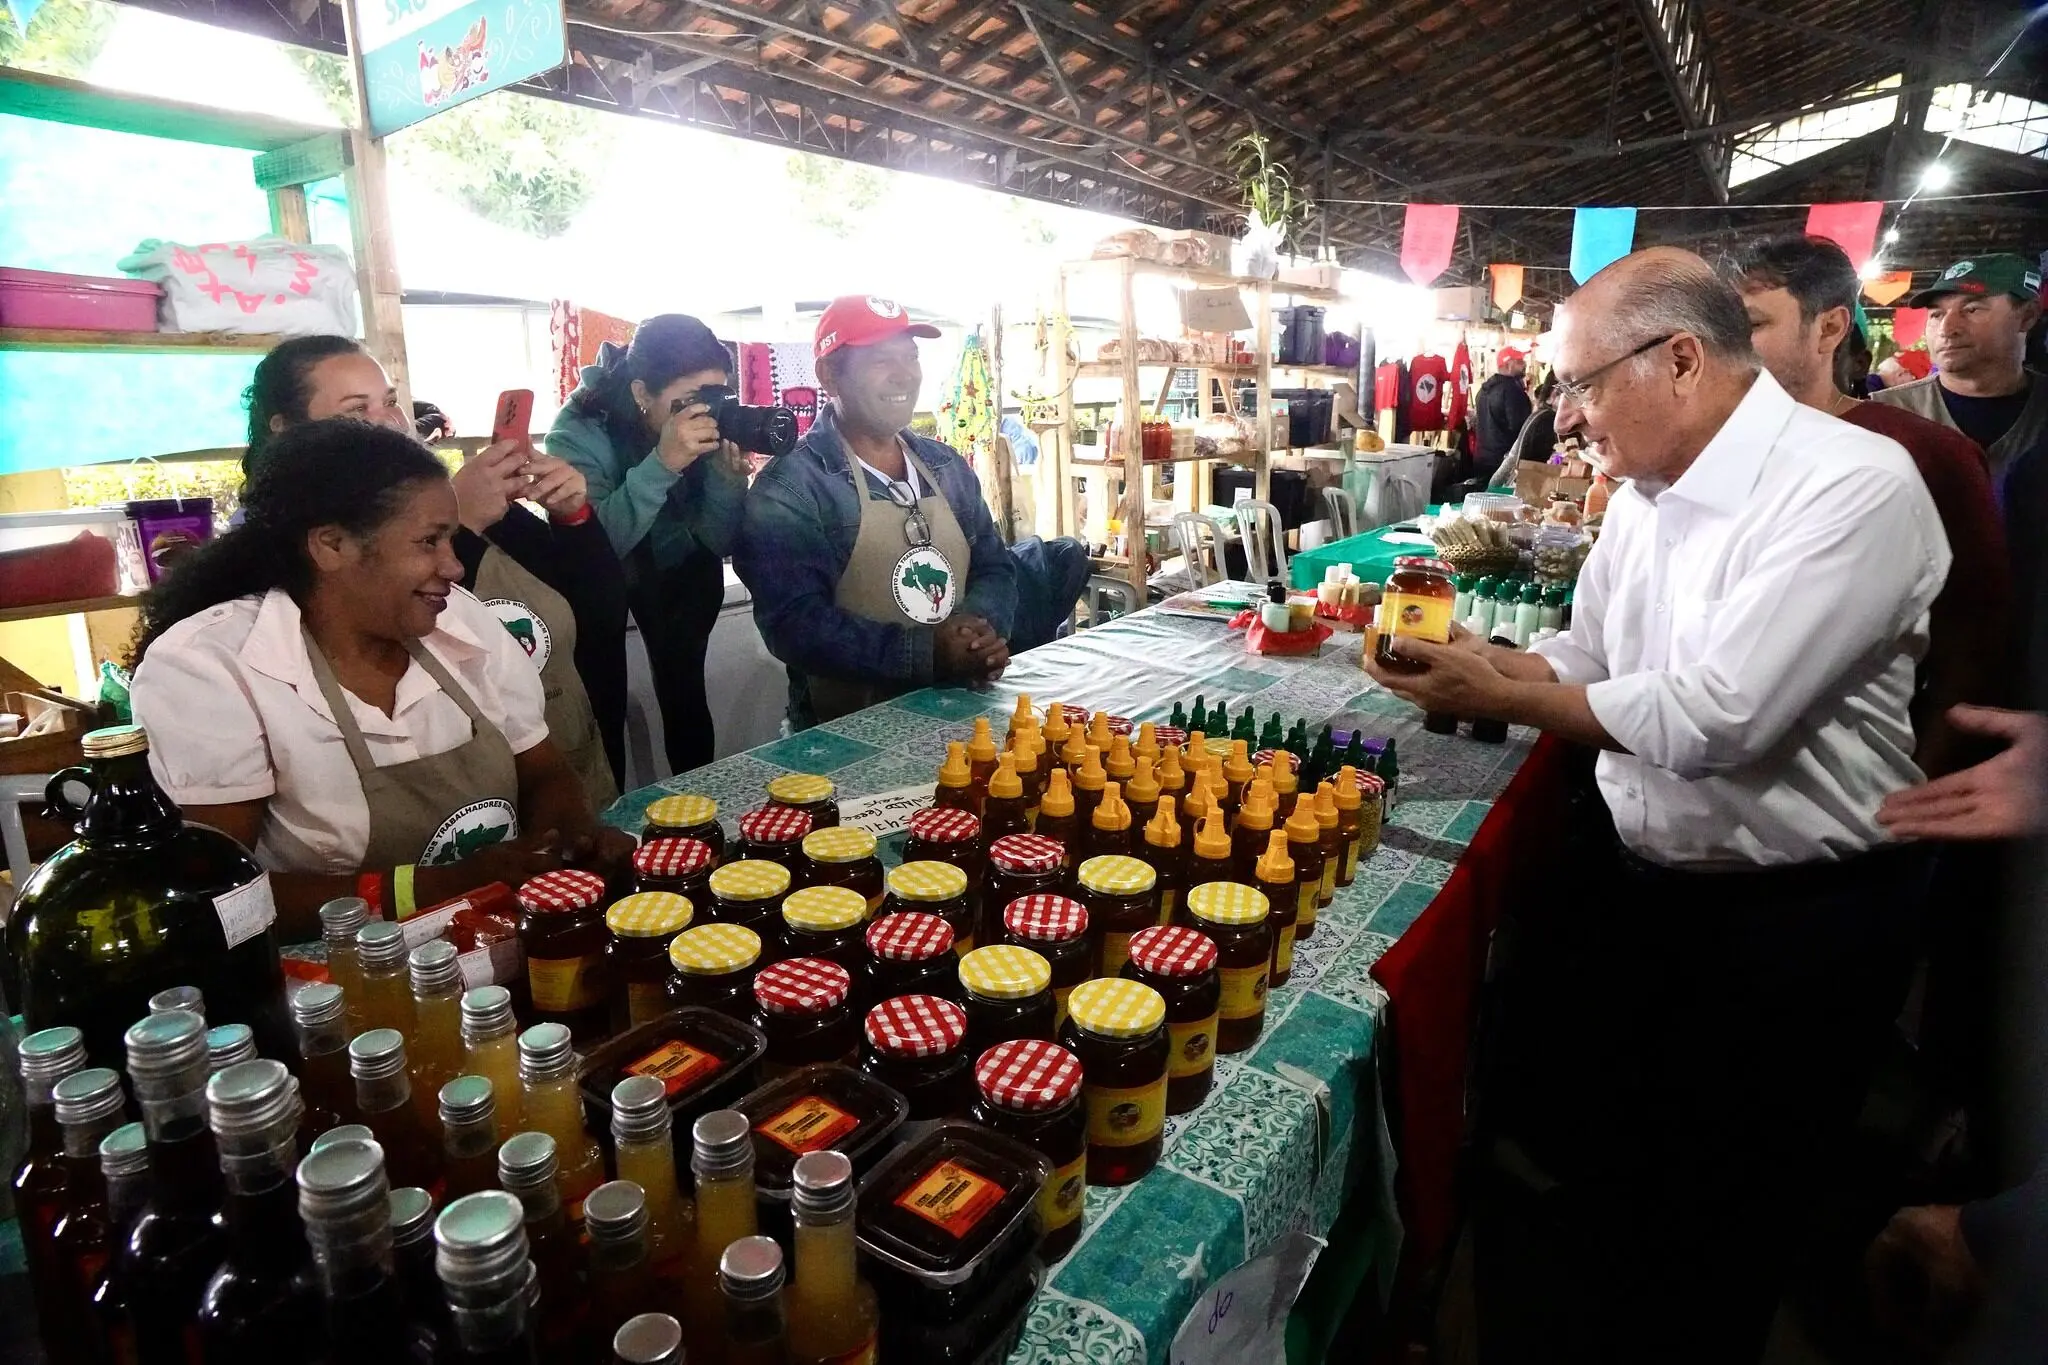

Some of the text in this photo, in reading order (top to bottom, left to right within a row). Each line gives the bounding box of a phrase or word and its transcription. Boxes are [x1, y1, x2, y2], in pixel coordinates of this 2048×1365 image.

[819, 331, 837, 352] MST
[901, 547, 939, 564] TRABALHADORES
[893, 578, 910, 613] MOVIMENTO
[484, 600, 551, 659] DORES RURAIS SEM TERRA
[424, 840, 438, 858] DOS
[436, 800, 502, 839] TRABALHADORES
